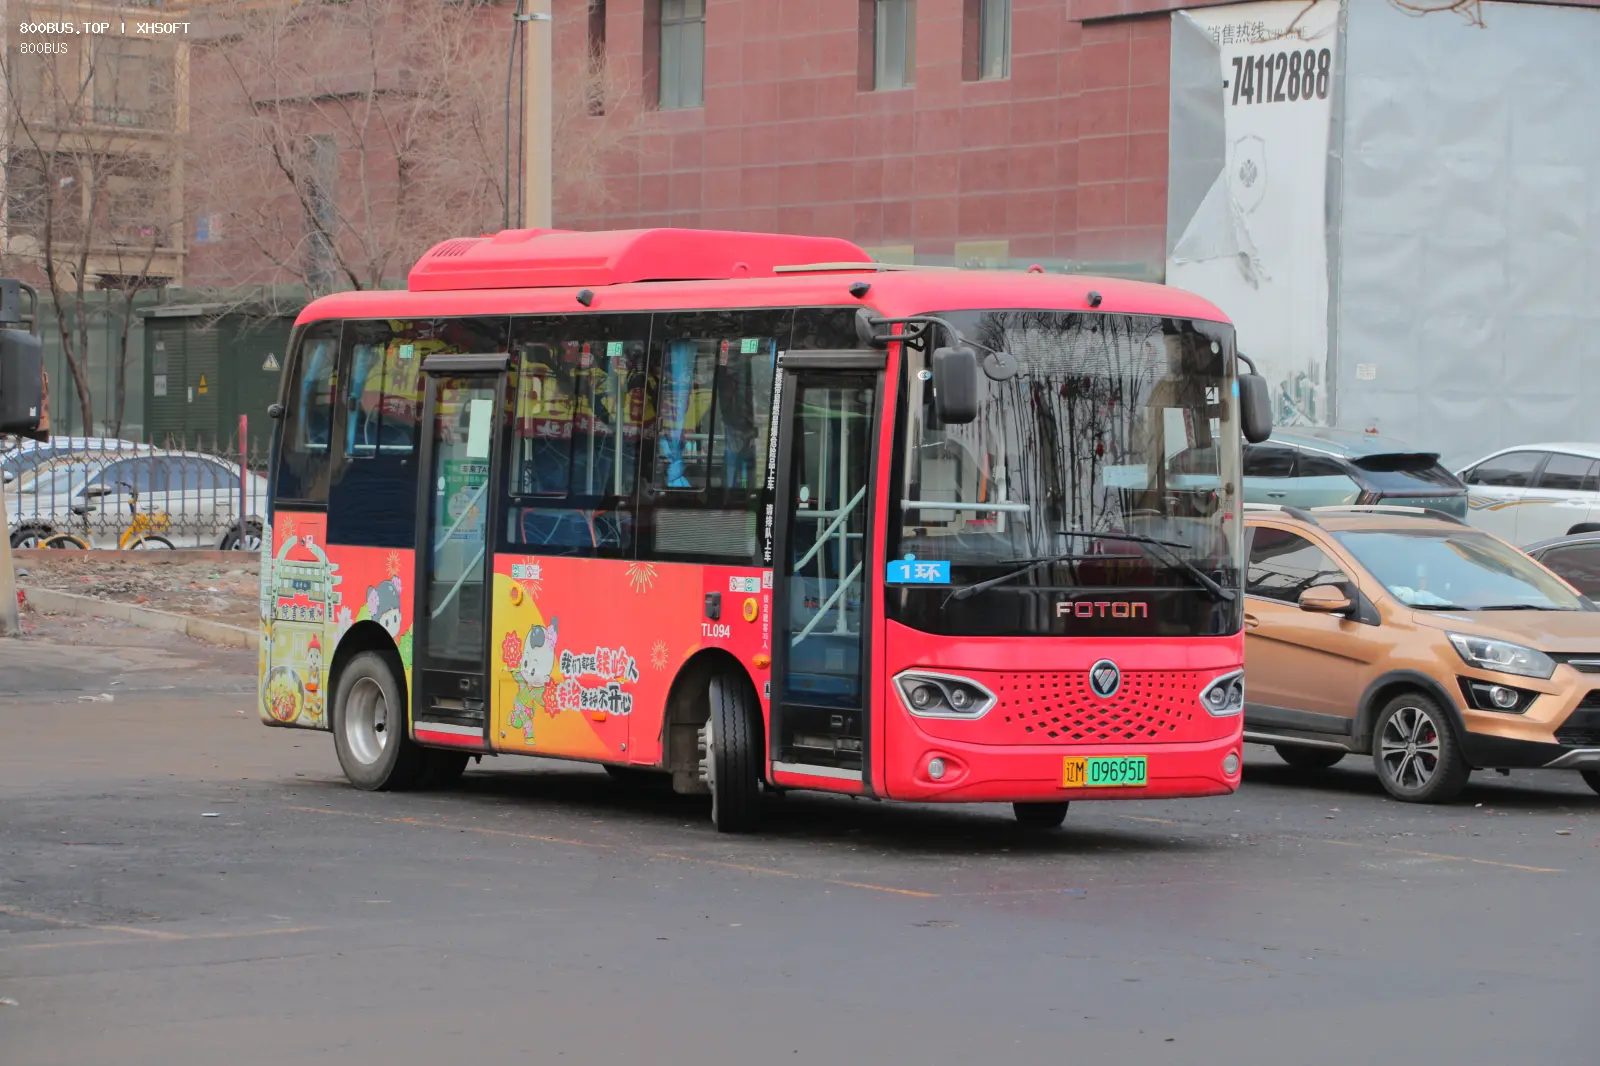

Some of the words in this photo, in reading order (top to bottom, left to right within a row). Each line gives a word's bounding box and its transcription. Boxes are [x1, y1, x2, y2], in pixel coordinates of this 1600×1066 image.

[1208, 21, 1265, 45] 销售热线
[900, 563, 941, 582] 1环
[1055, 601, 1148, 618] FOTON
[701, 622, 731, 638] TL094
[559, 647, 639, 683] 我们都是铁岭人
[557, 679, 633, 714] 专治各种不开心
[1066, 761, 1084, 782] 辽M
[1091, 760, 1146, 782] 09695D
